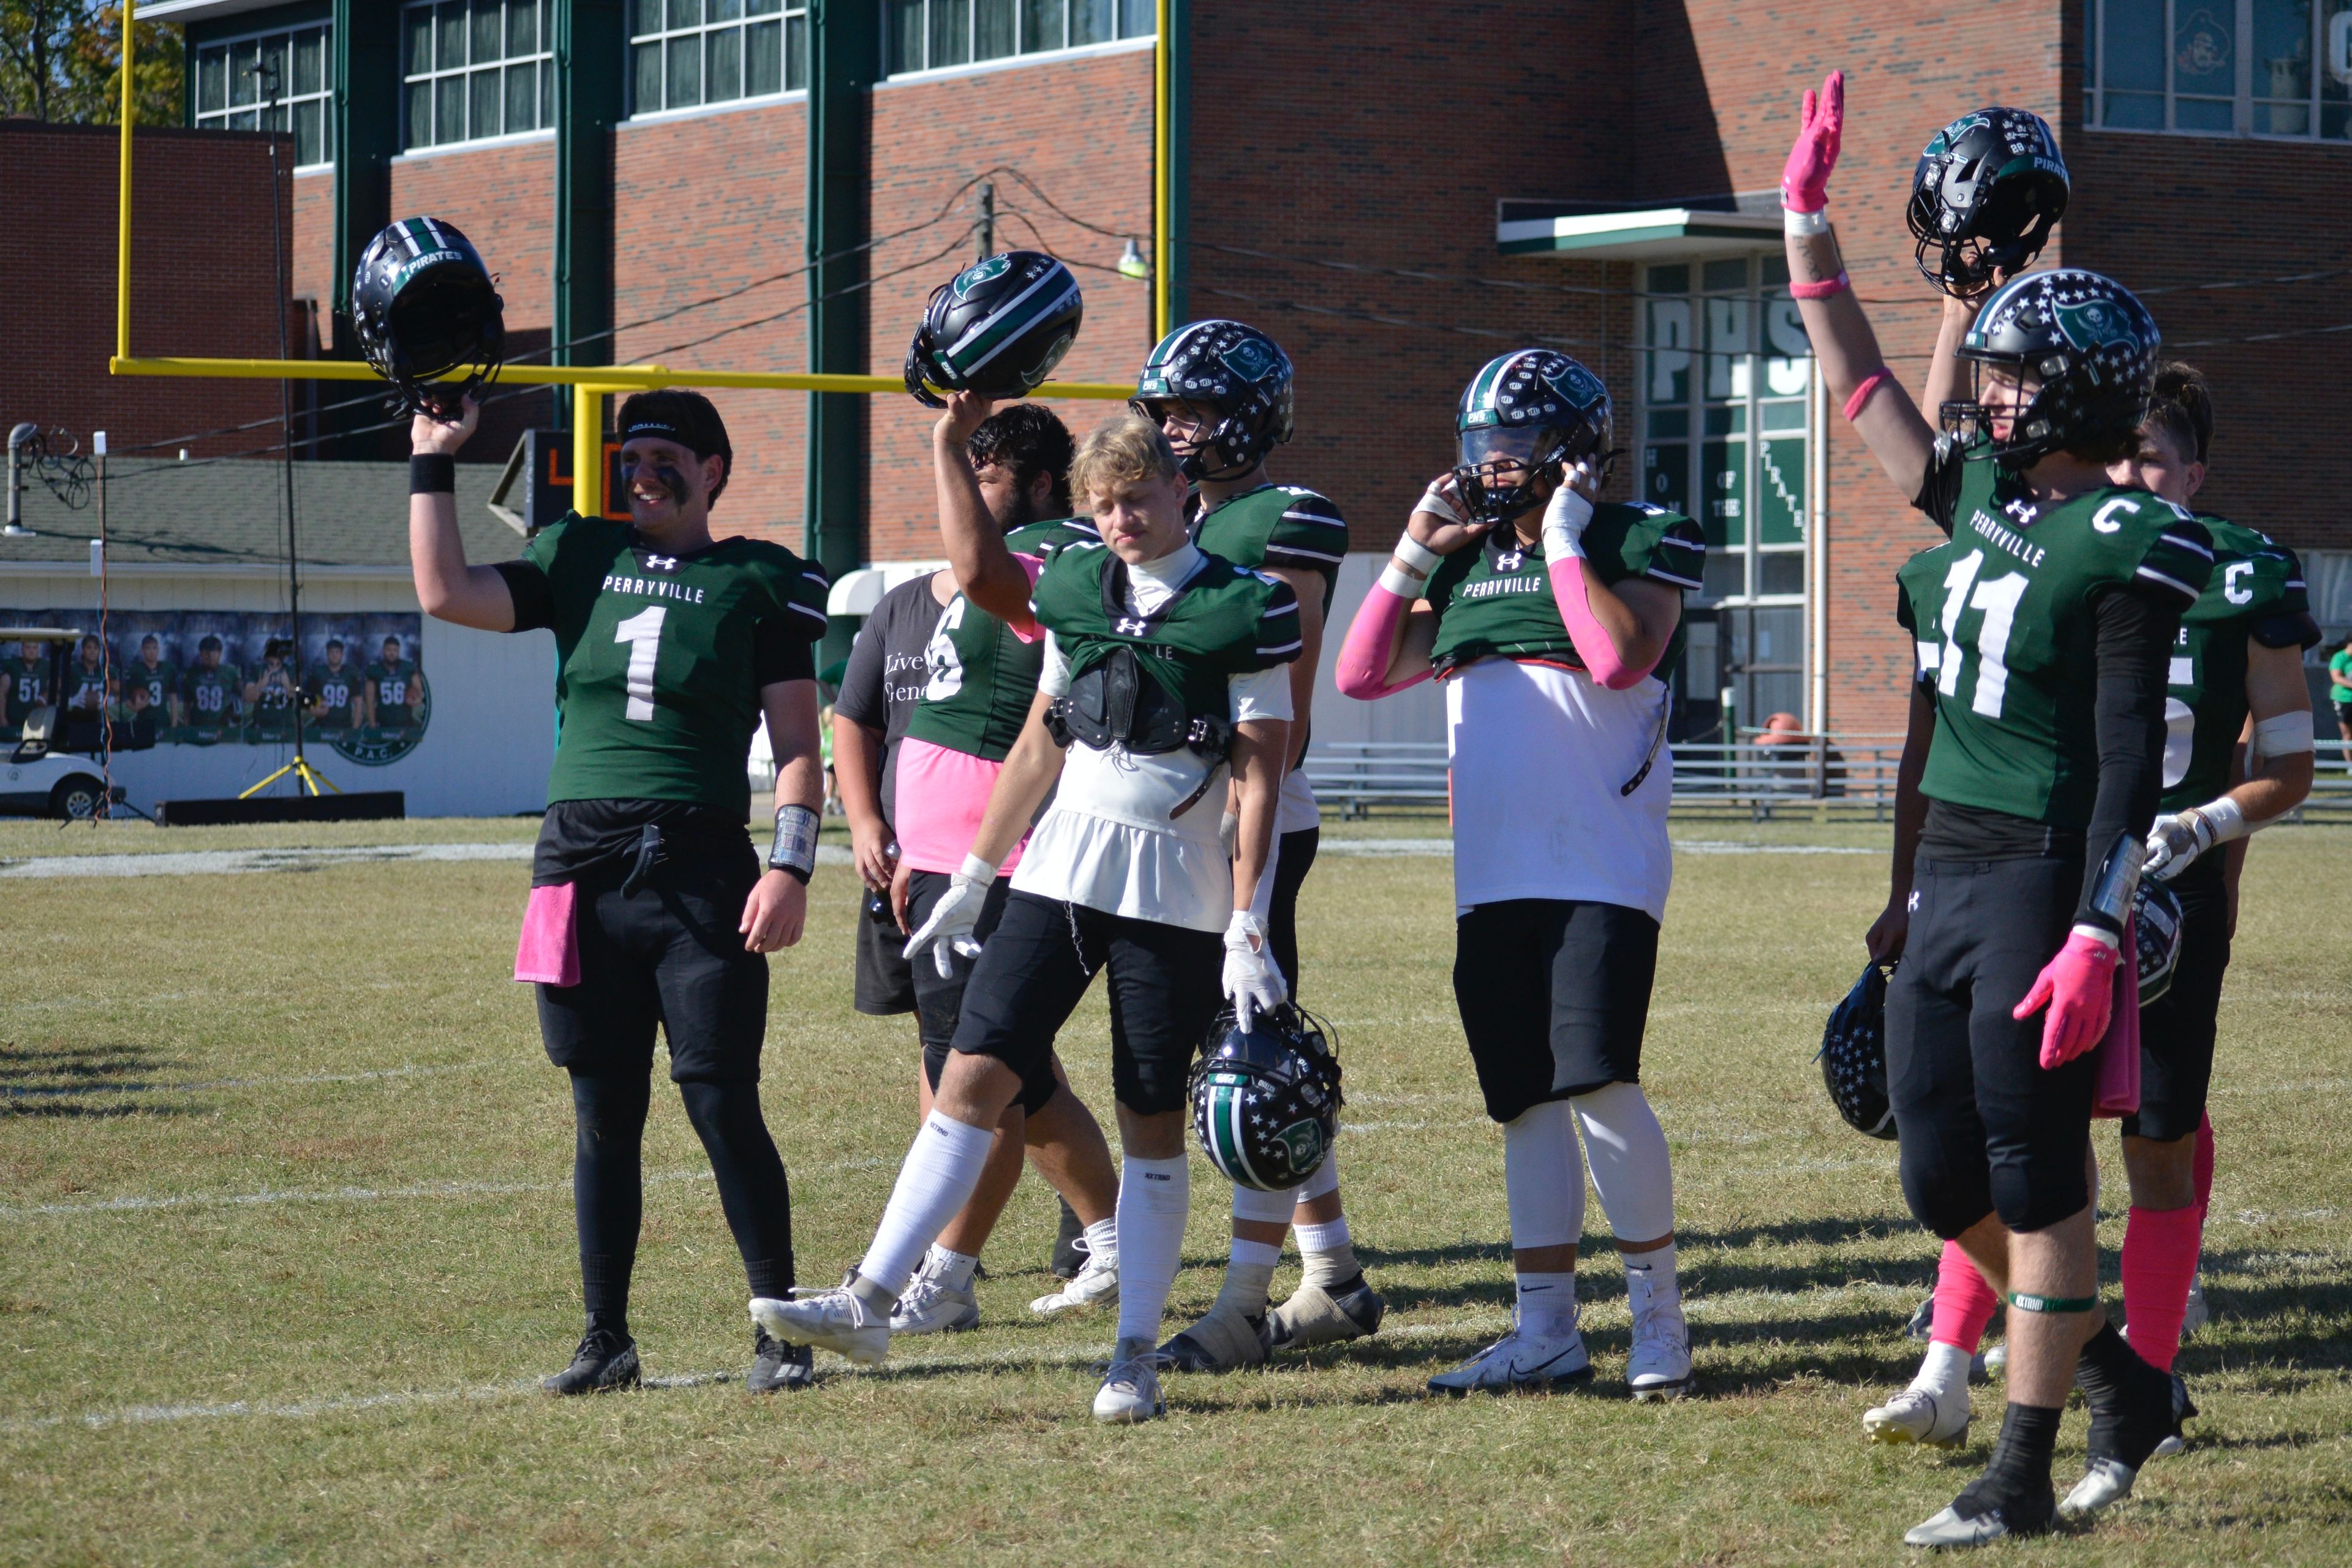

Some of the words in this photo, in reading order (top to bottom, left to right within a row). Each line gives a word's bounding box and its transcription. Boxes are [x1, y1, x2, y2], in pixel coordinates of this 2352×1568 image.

[408, 251, 463, 274] PIRATES
[1652, 290, 1812, 401] PHS
[1185, 379, 1198, 390] TEAM
[1199, 377, 1213, 388] TEAM
[1467, 412, 1486, 423] PHS
[1511, 410, 1524, 420] TEAM
[1527, 407, 1540, 417] TEAM
[1716, 470, 1736, 489] OF
[1712, 499, 1741, 518] THE
[2092, 498, 2141, 533] C
[1969, 509, 2046, 568] PERRYVILLE
[602, 576, 704, 604] PERRYVILLE
[1462, 577, 1541, 598] PERRYVILLE
[2225, 562, 2254, 605] C
[1938, 548, 2029, 720] 11
[614, 605, 668, 721] 1
[885, 652, 924, 676] Live
[2015, 1294, 2044, 1311] NXTRND
